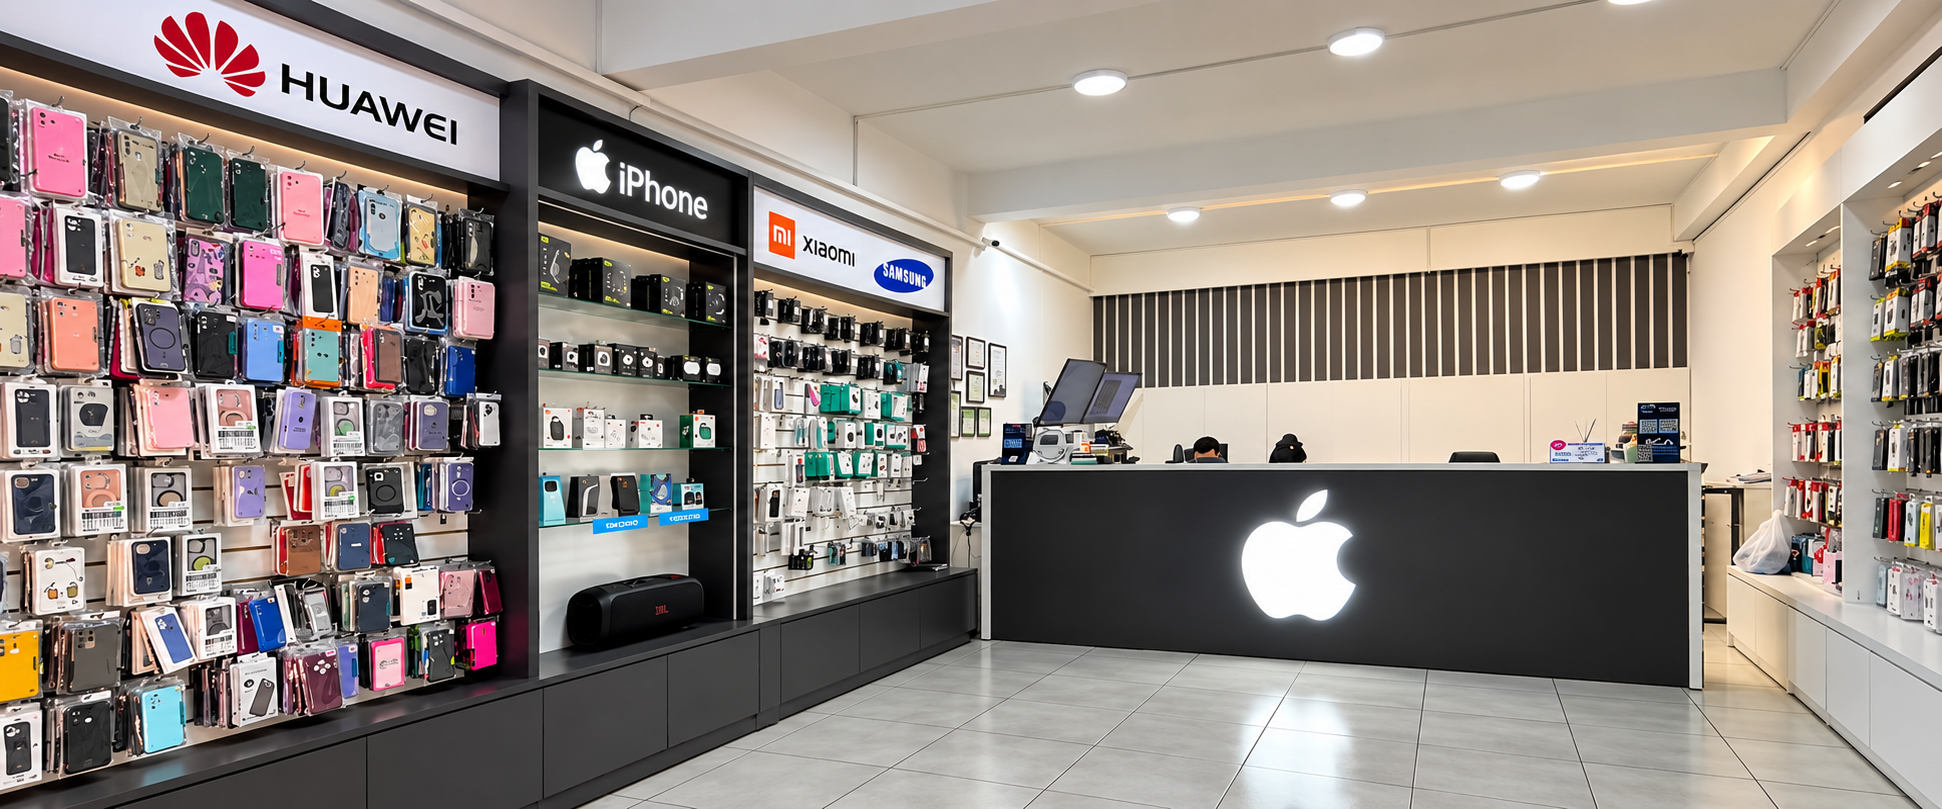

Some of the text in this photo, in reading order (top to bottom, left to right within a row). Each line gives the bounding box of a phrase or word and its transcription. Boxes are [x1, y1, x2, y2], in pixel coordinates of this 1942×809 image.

[281, 62, 458, 146] HUAWEI
[619, 161, 708, 220] iPhone
[882, 262, 927, 289] SAMSUNG
